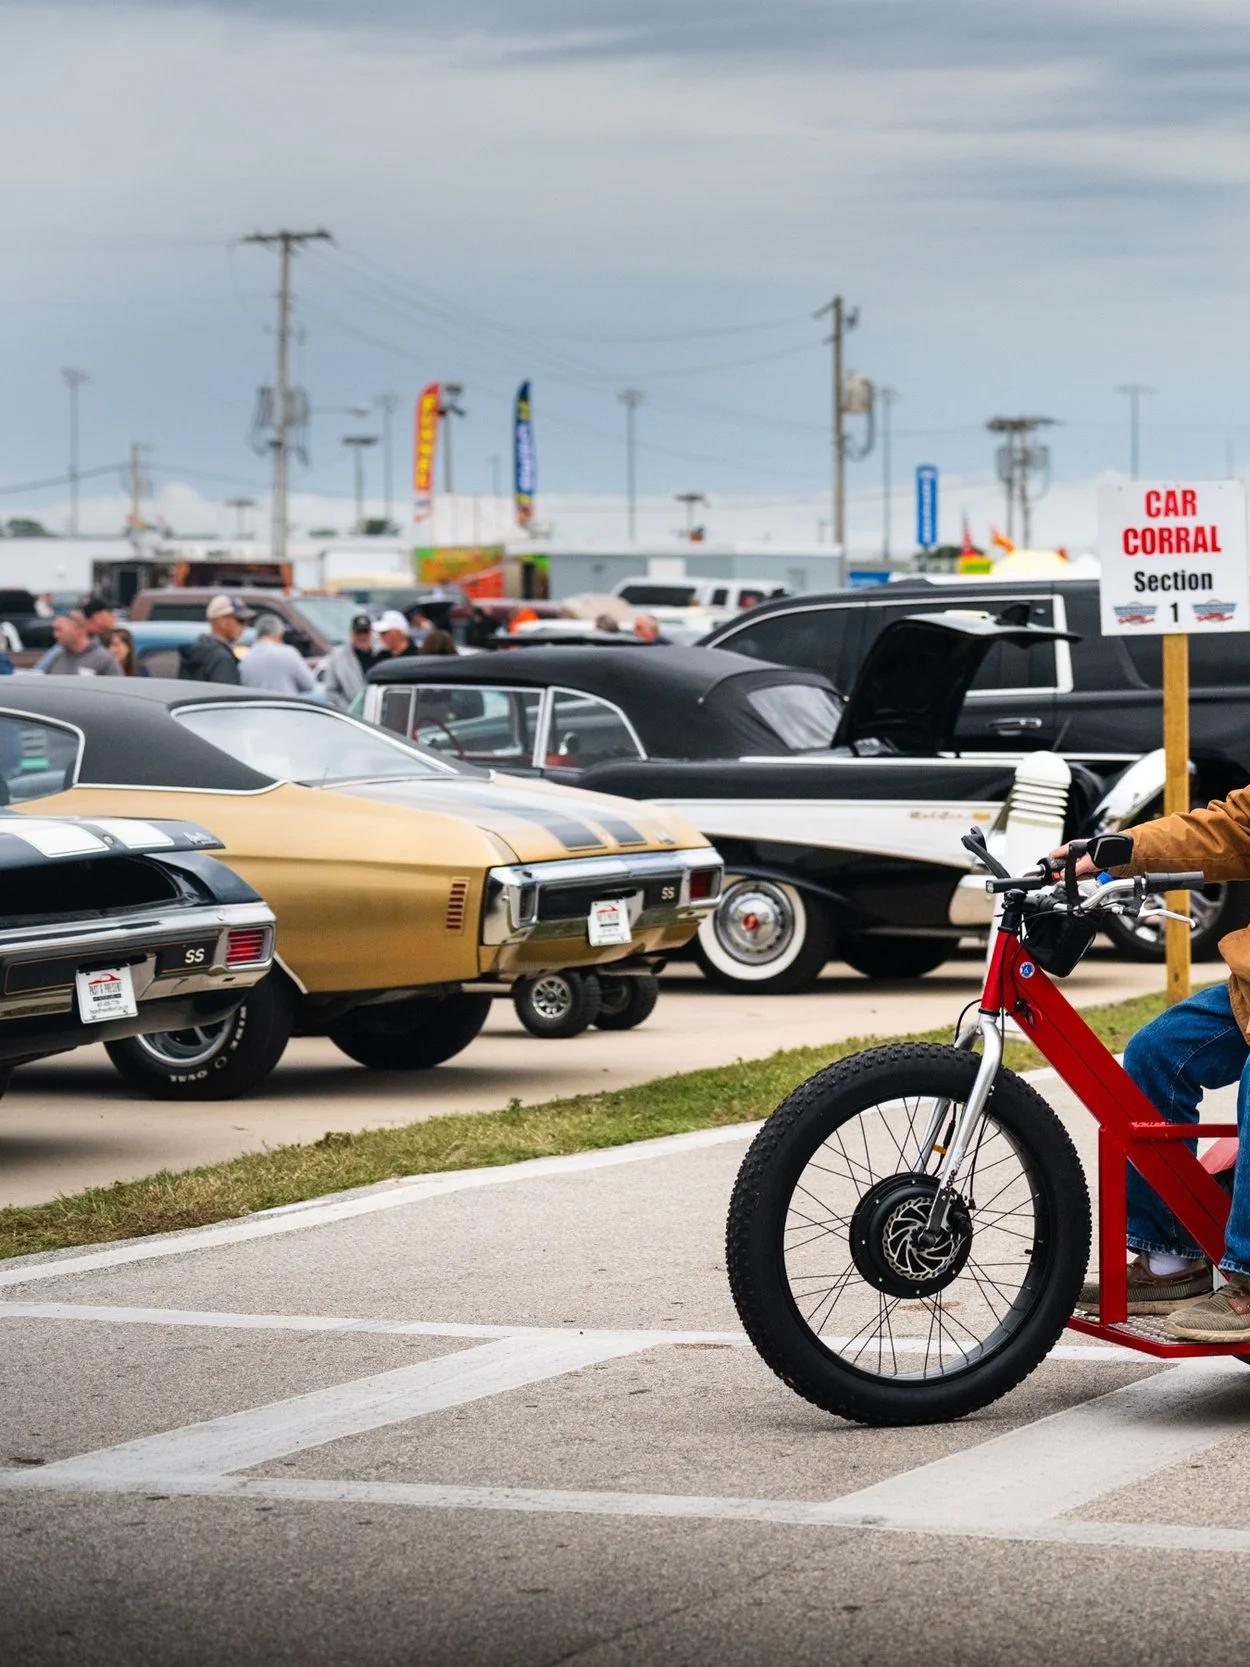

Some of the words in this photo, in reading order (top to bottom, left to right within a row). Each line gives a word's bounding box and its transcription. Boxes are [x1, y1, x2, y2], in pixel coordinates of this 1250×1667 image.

[1145, 489, 1197, 519] CAR
[1123, 526, 1222, 556] CORRAL
[1134, 570, 1213, 593] Section
[1170, 602, 1179, 623] 1
[661, 887, 675, 899] SS
[184, 947, 206, 964] SS
